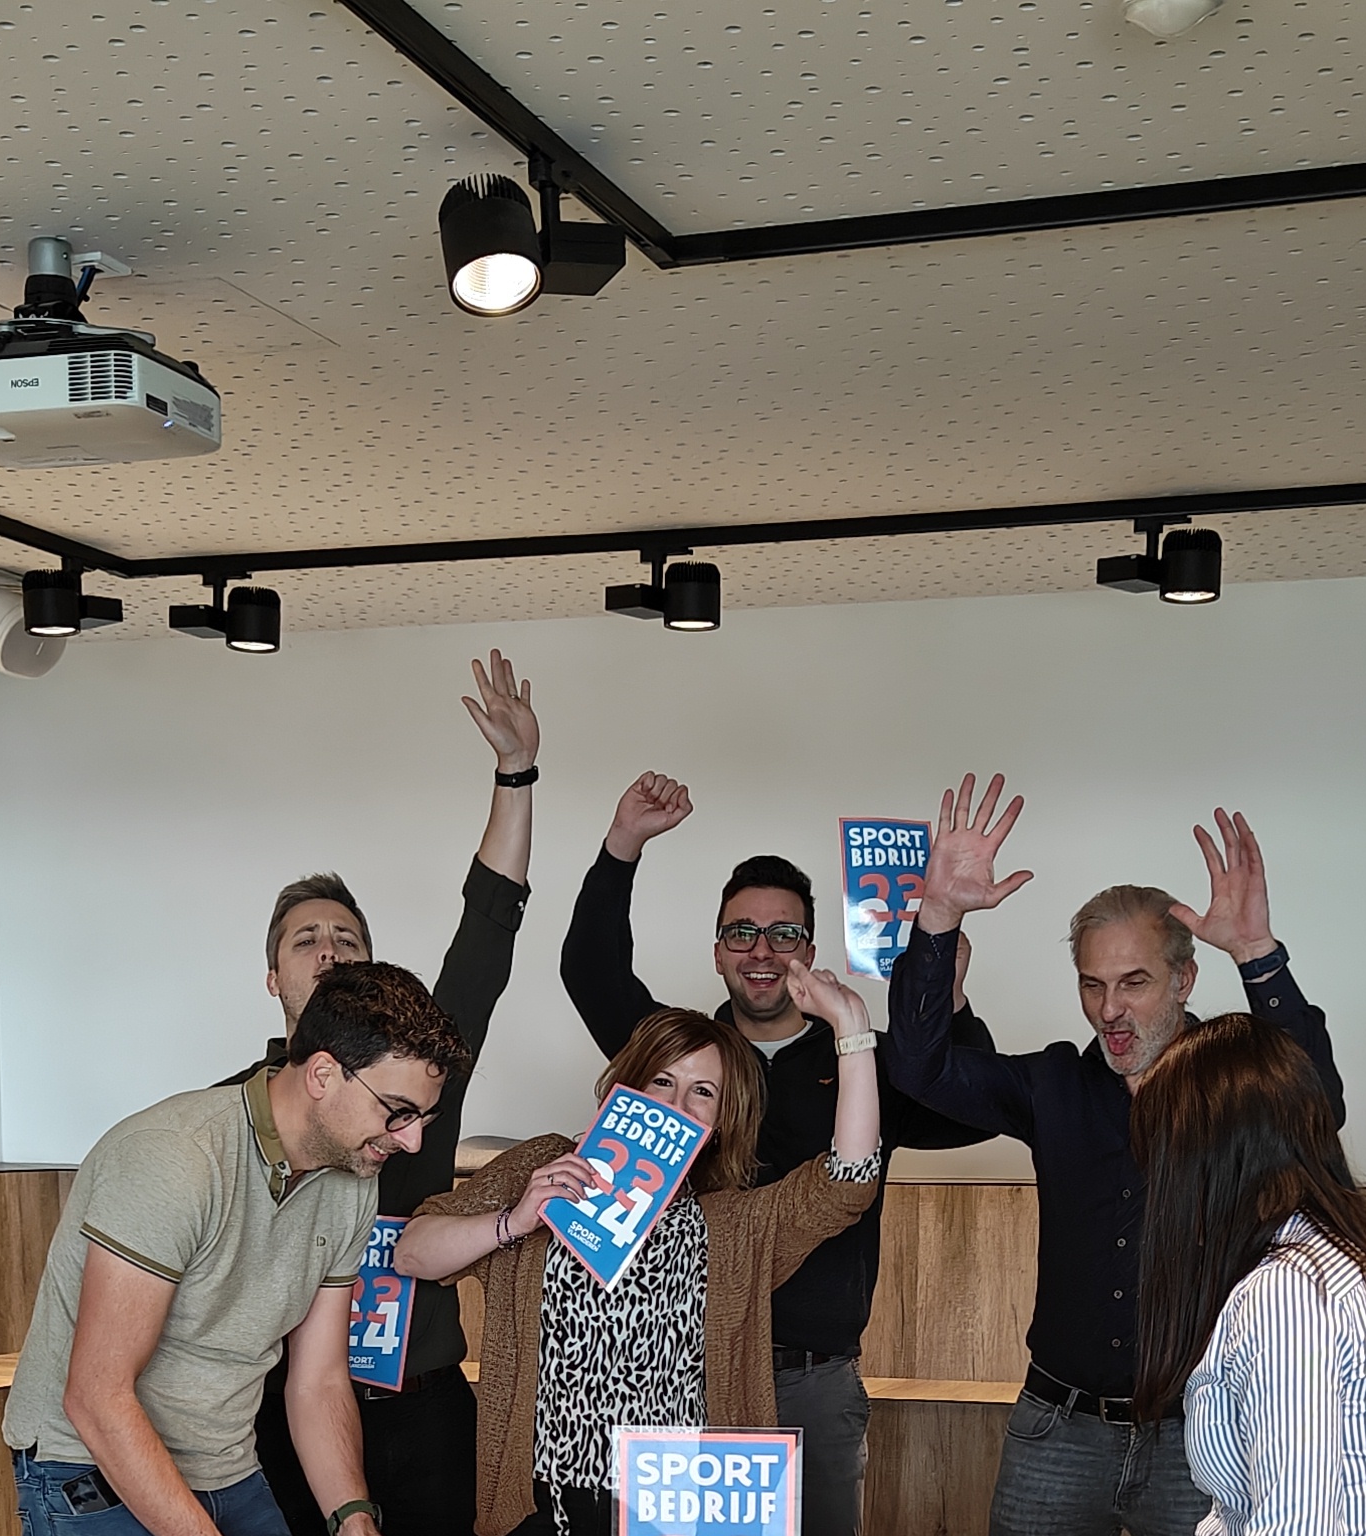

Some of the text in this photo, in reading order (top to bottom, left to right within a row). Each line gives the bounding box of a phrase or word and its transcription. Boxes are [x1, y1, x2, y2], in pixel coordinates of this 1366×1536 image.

[11, 378, 39, 389] EPSON
[848, 827, 924, 848] SPORT
[851, 847, 927, 868] BEDRIJF
[859, 873, 925, 922] 23
[601, 1111, 686, 1167] BEDRIJF
[612, 1096, 697, 1147] SPORT
[592, 1138, 665, 1212] 23
[565, 1157, 654, 1249] 24
[348, 1355, 376, 1365] PORT.
[635, 1452, 780, 1487] SPORT
[637, 1488, 776, 1525] BEDRIJF
